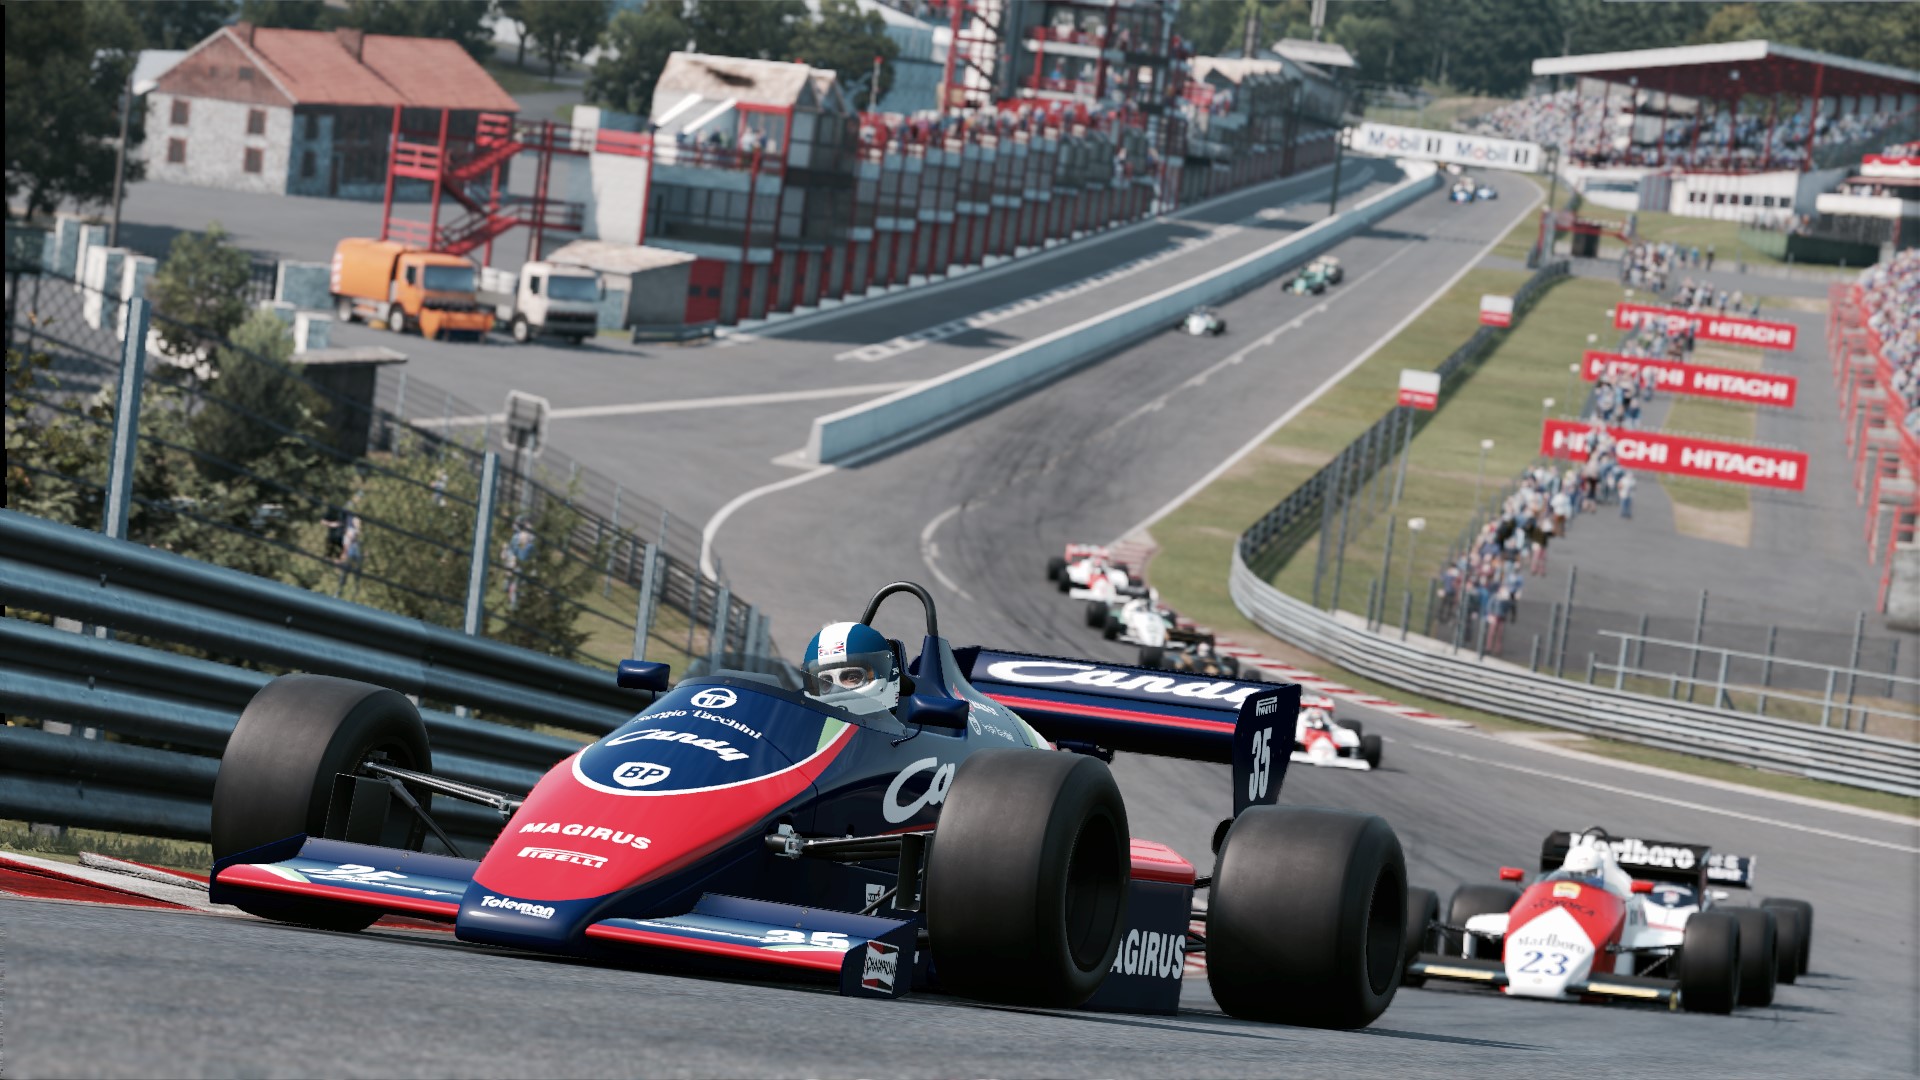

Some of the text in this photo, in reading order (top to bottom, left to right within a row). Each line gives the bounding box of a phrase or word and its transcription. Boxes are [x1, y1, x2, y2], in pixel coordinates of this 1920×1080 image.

[1621, 307, 1791, 345] HTCHI HITACHI
[1591, 358, 1790, 401] HICHI HITACHI
[1553, 429, 1798, 482] HICHI HITACHI
[987, 660, 1261, 709] Candy
[605, 728, 749, 762] Candy
[1248, 726, 1273, 802] 35
[619, 765, 666, 781] BP
[882, 757, 956, 824] Ca
[518, 822, 652, 850] MAGIRUS
[516, 846, 609, 869] PIRELLI
[481, 895, 556, 918] Toleman
[1109, 928, 1186, 979] AGIRUS
[1517, 950, 1570, 977] 23
